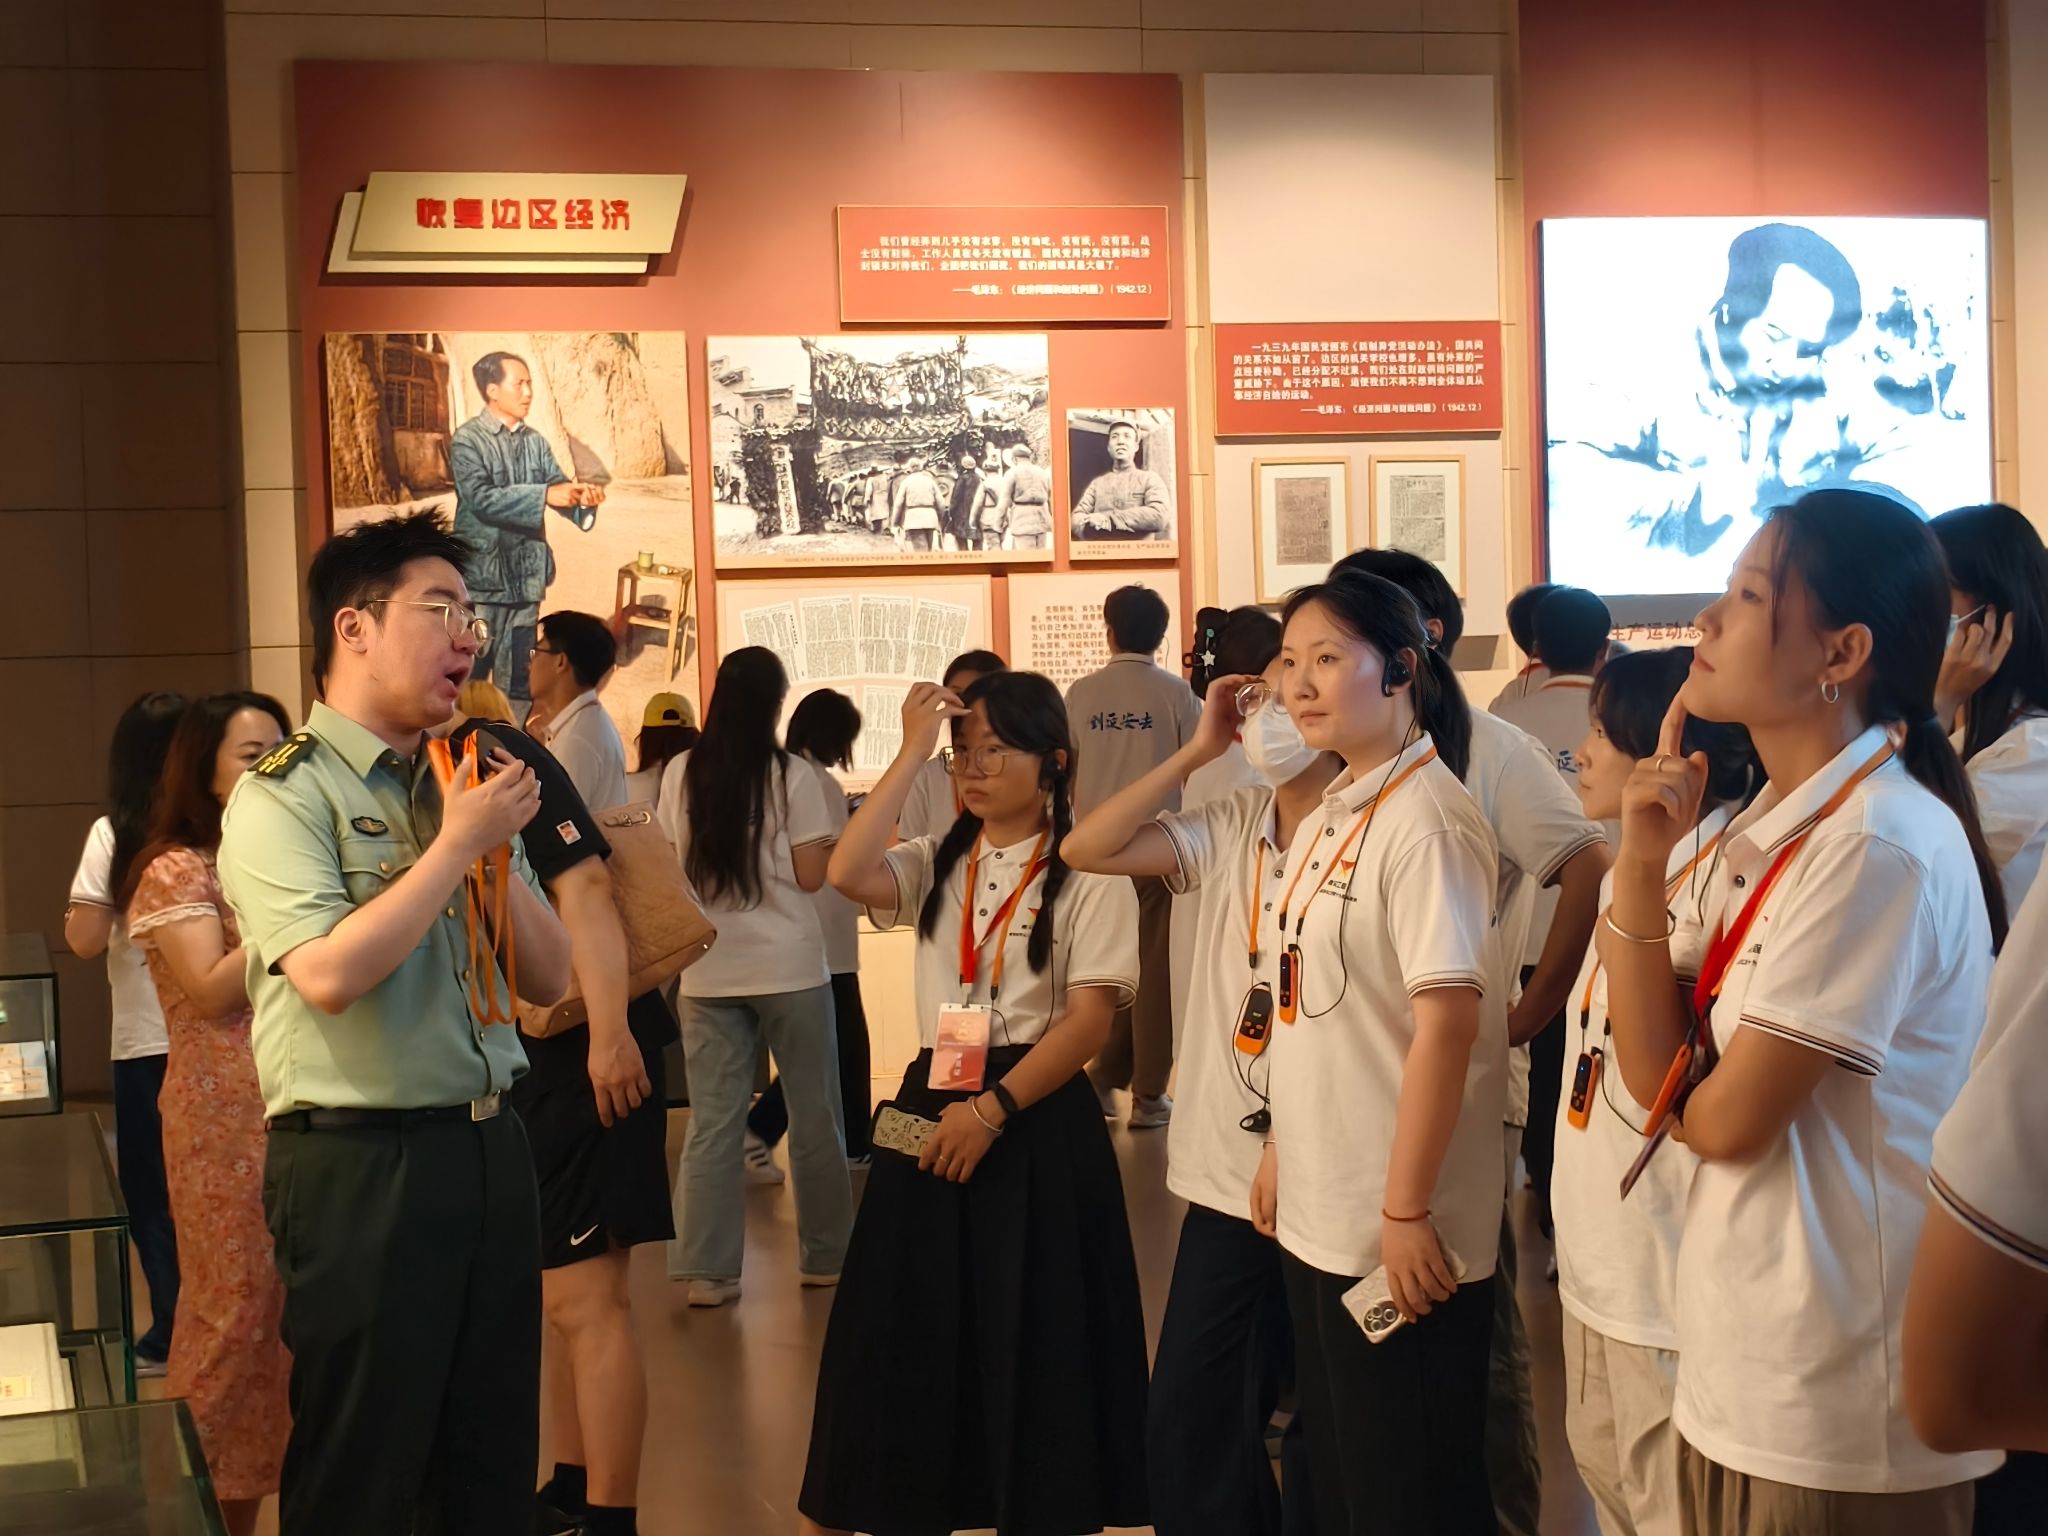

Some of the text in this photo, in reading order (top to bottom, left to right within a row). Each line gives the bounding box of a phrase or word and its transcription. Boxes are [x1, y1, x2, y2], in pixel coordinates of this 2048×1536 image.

[416, 198, 630, 230] 恢复边区经济
[1090, 711, 1153, 731] 到延安去
